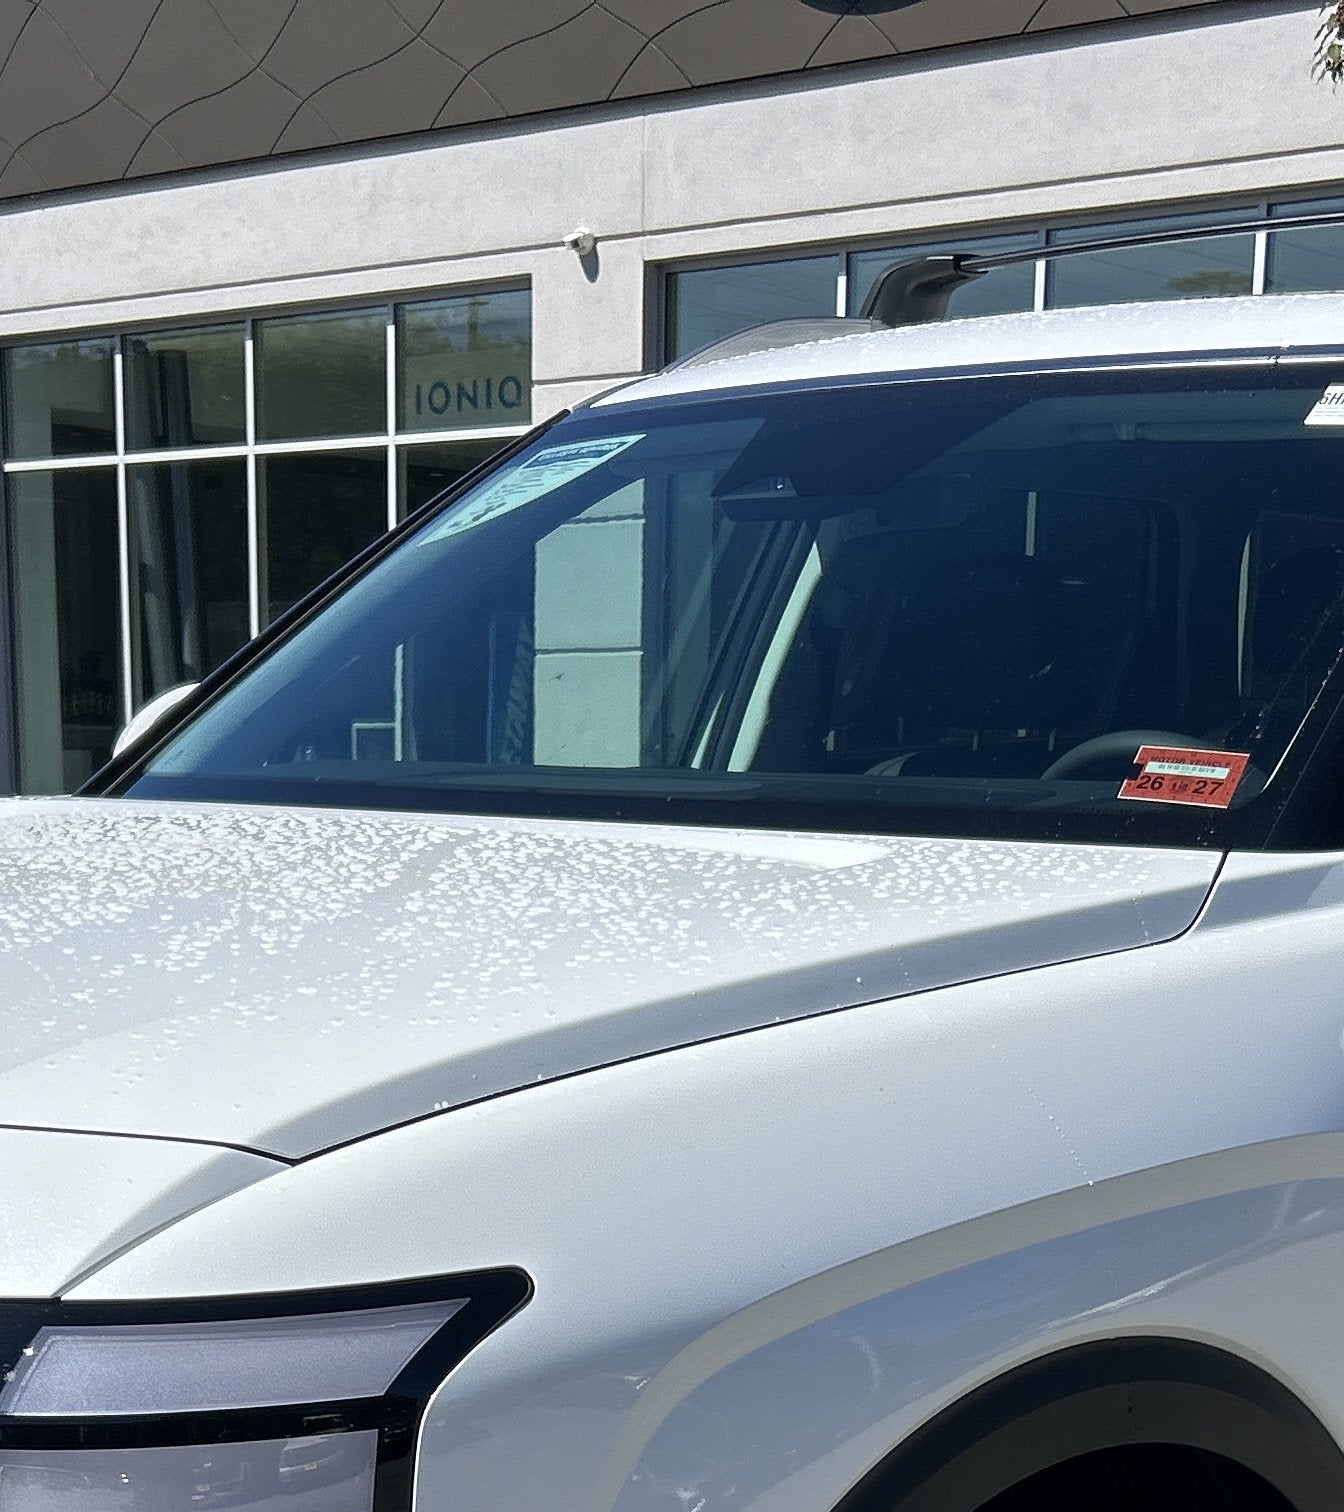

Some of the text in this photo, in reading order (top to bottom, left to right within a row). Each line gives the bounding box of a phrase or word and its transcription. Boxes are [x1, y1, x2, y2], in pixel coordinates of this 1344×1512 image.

[415, 375, 522, 415] IONIQ
[1136, 775, 1224, 796] 26 27
